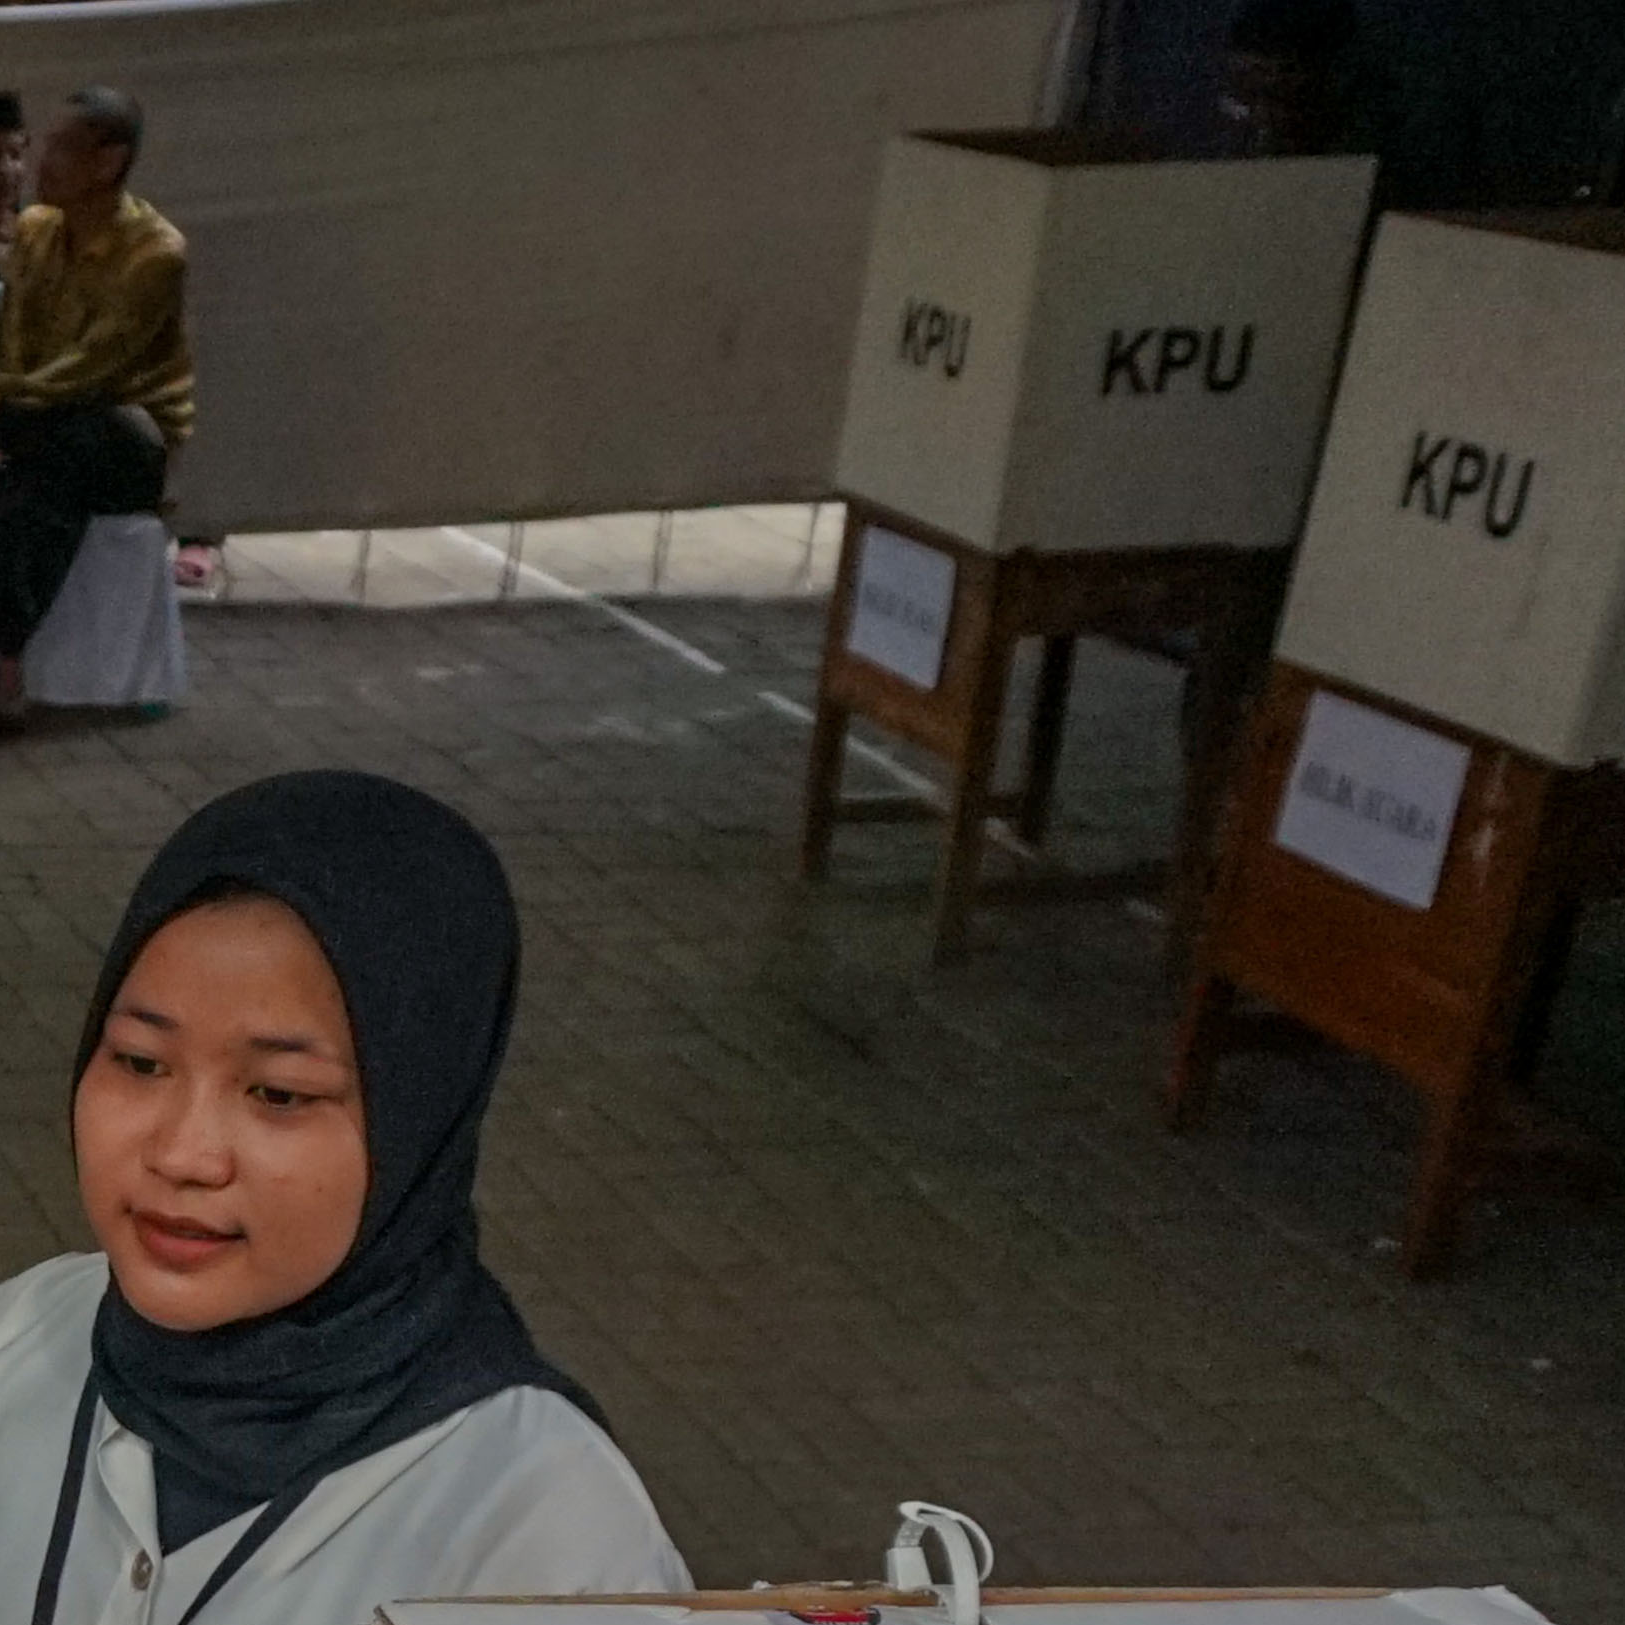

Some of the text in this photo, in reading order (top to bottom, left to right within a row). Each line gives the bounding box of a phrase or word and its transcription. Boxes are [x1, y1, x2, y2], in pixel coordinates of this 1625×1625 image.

[898, 300, 972, 379] KPU
[1101, 323, 1255, 397] KPU
[1398, 431, 1535, 540] KPU
